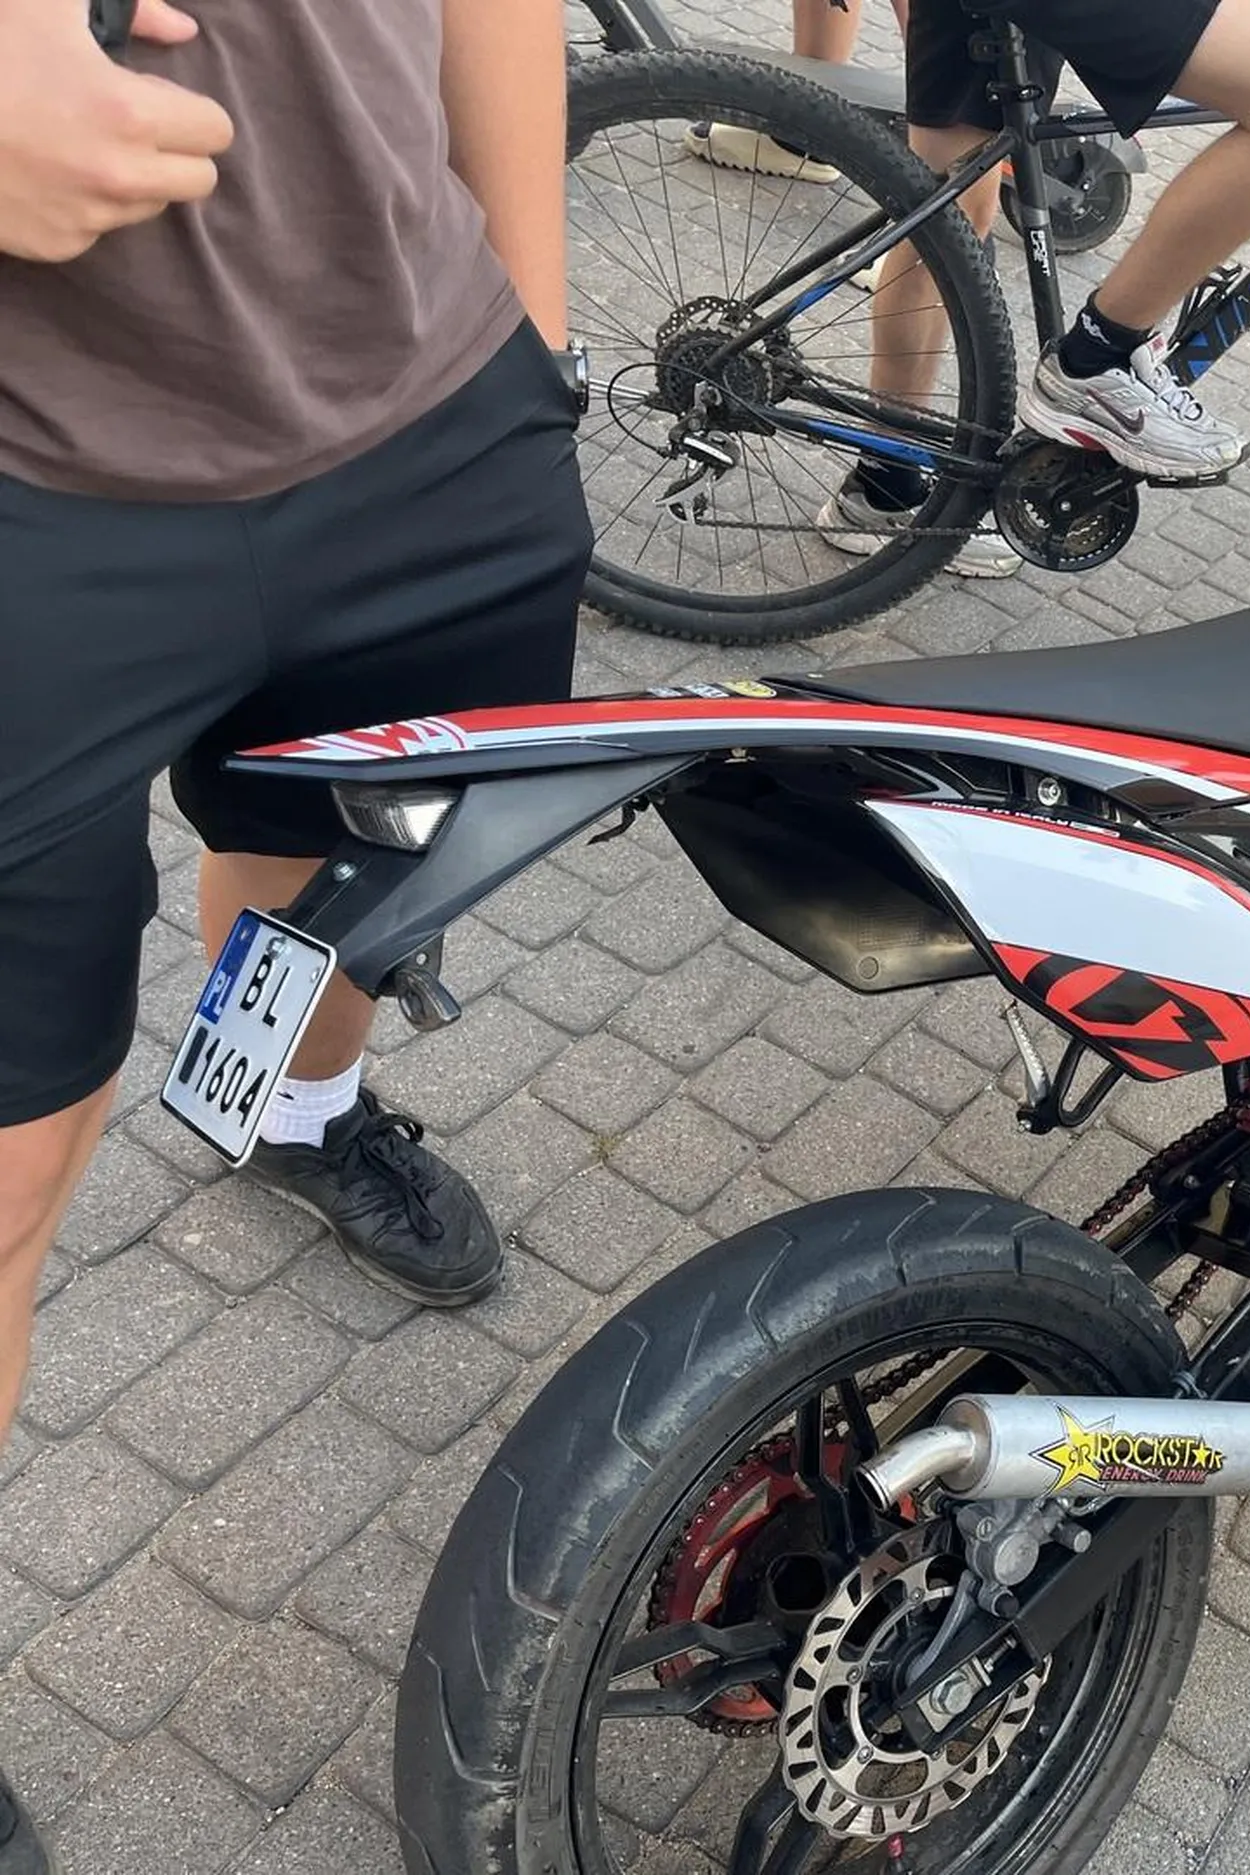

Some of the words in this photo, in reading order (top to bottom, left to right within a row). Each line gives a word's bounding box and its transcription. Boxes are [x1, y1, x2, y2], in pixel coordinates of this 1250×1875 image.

[205, 970, 232, 1017] PL
[239, 955, 291, 1028] BL
[195, 1037, 268, 1128] 1604
[1165, 1468, 1210, 1484] DRINK
